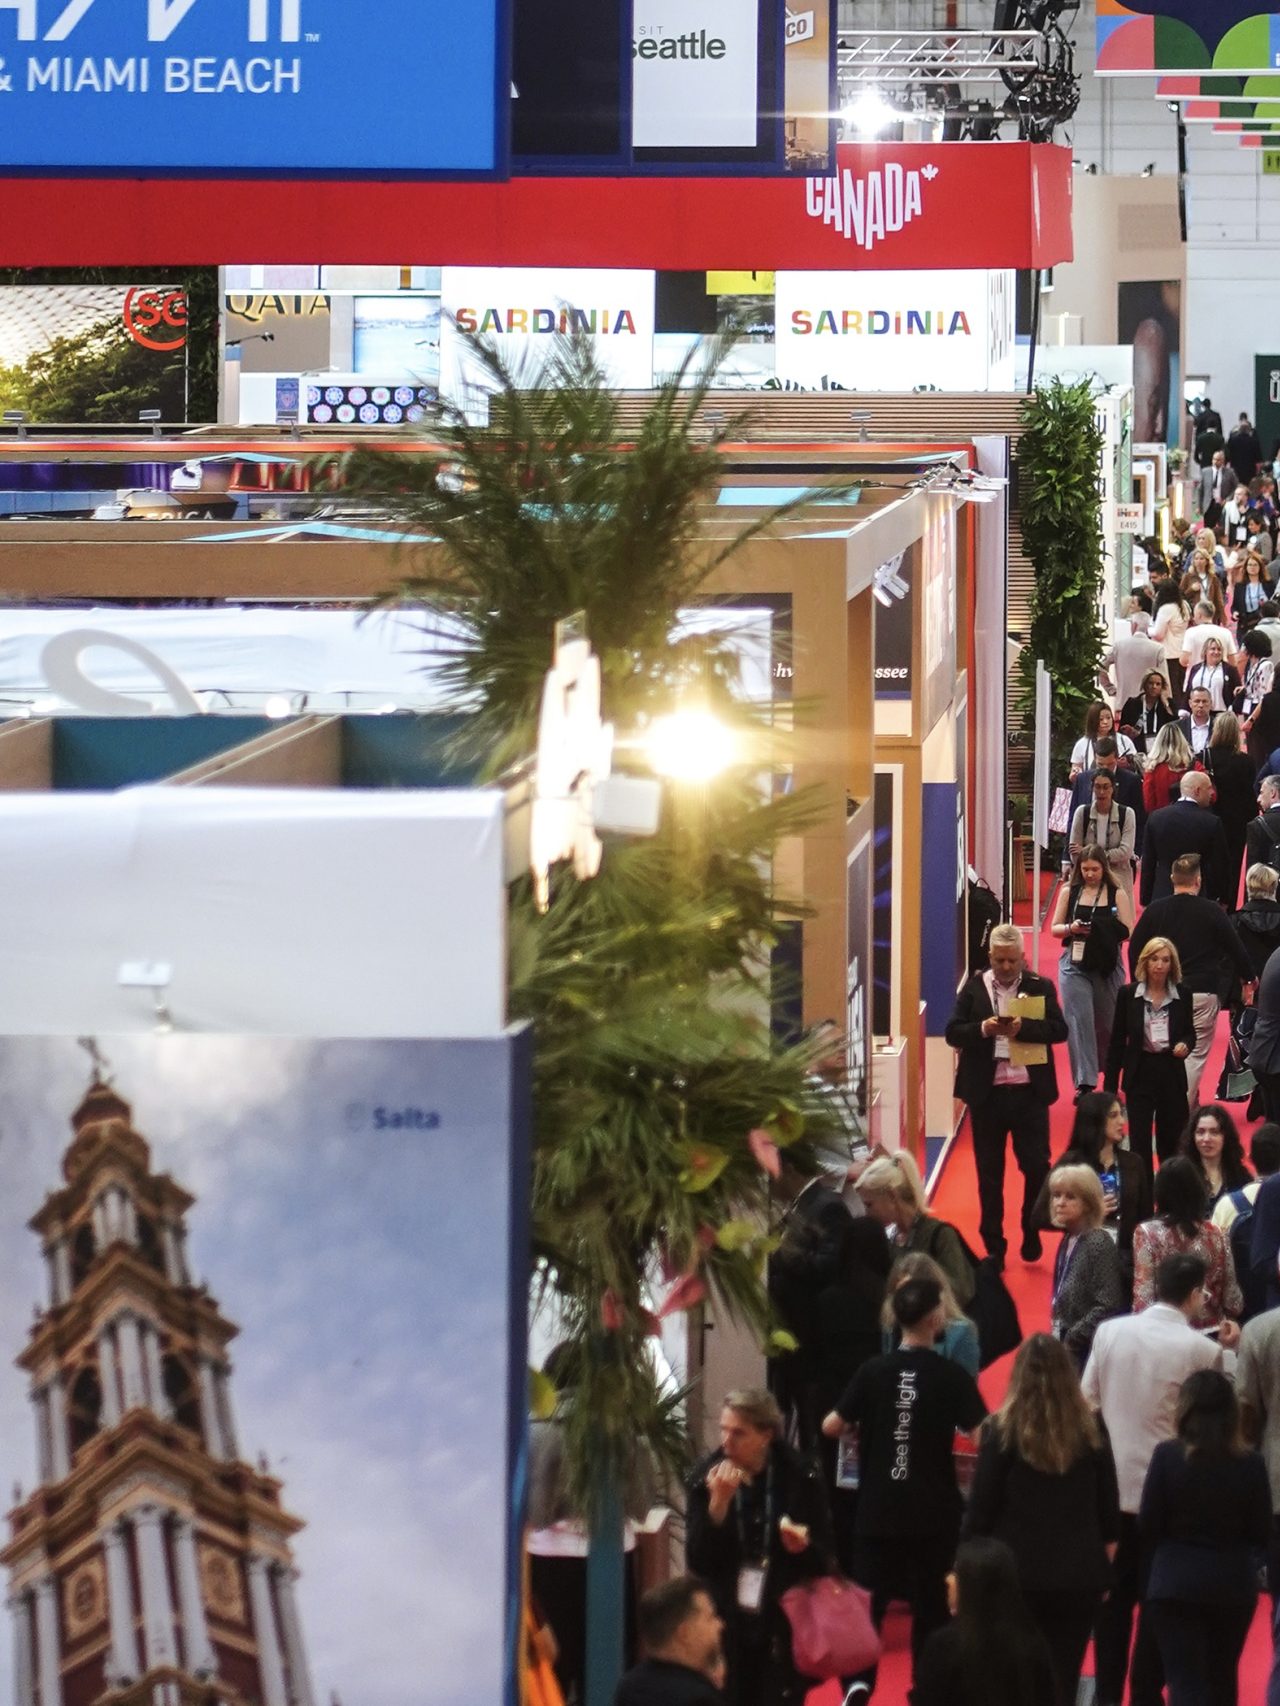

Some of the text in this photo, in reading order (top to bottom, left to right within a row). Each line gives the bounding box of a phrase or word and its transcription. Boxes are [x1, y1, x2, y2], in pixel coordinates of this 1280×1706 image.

[638, 25, 664, 36] SIT
[27, 57, 149, 92] MIAMI
[164, 57, 300, 93] BEACH
[806, 163, 922, 250] CANADA
[226, 295, 331, 321] QATA
[456, 308, 636, 334] SARDINIA
[791, 310, 972, 336] SARDINIA
[891, 1371, 917, 1480] See the light
